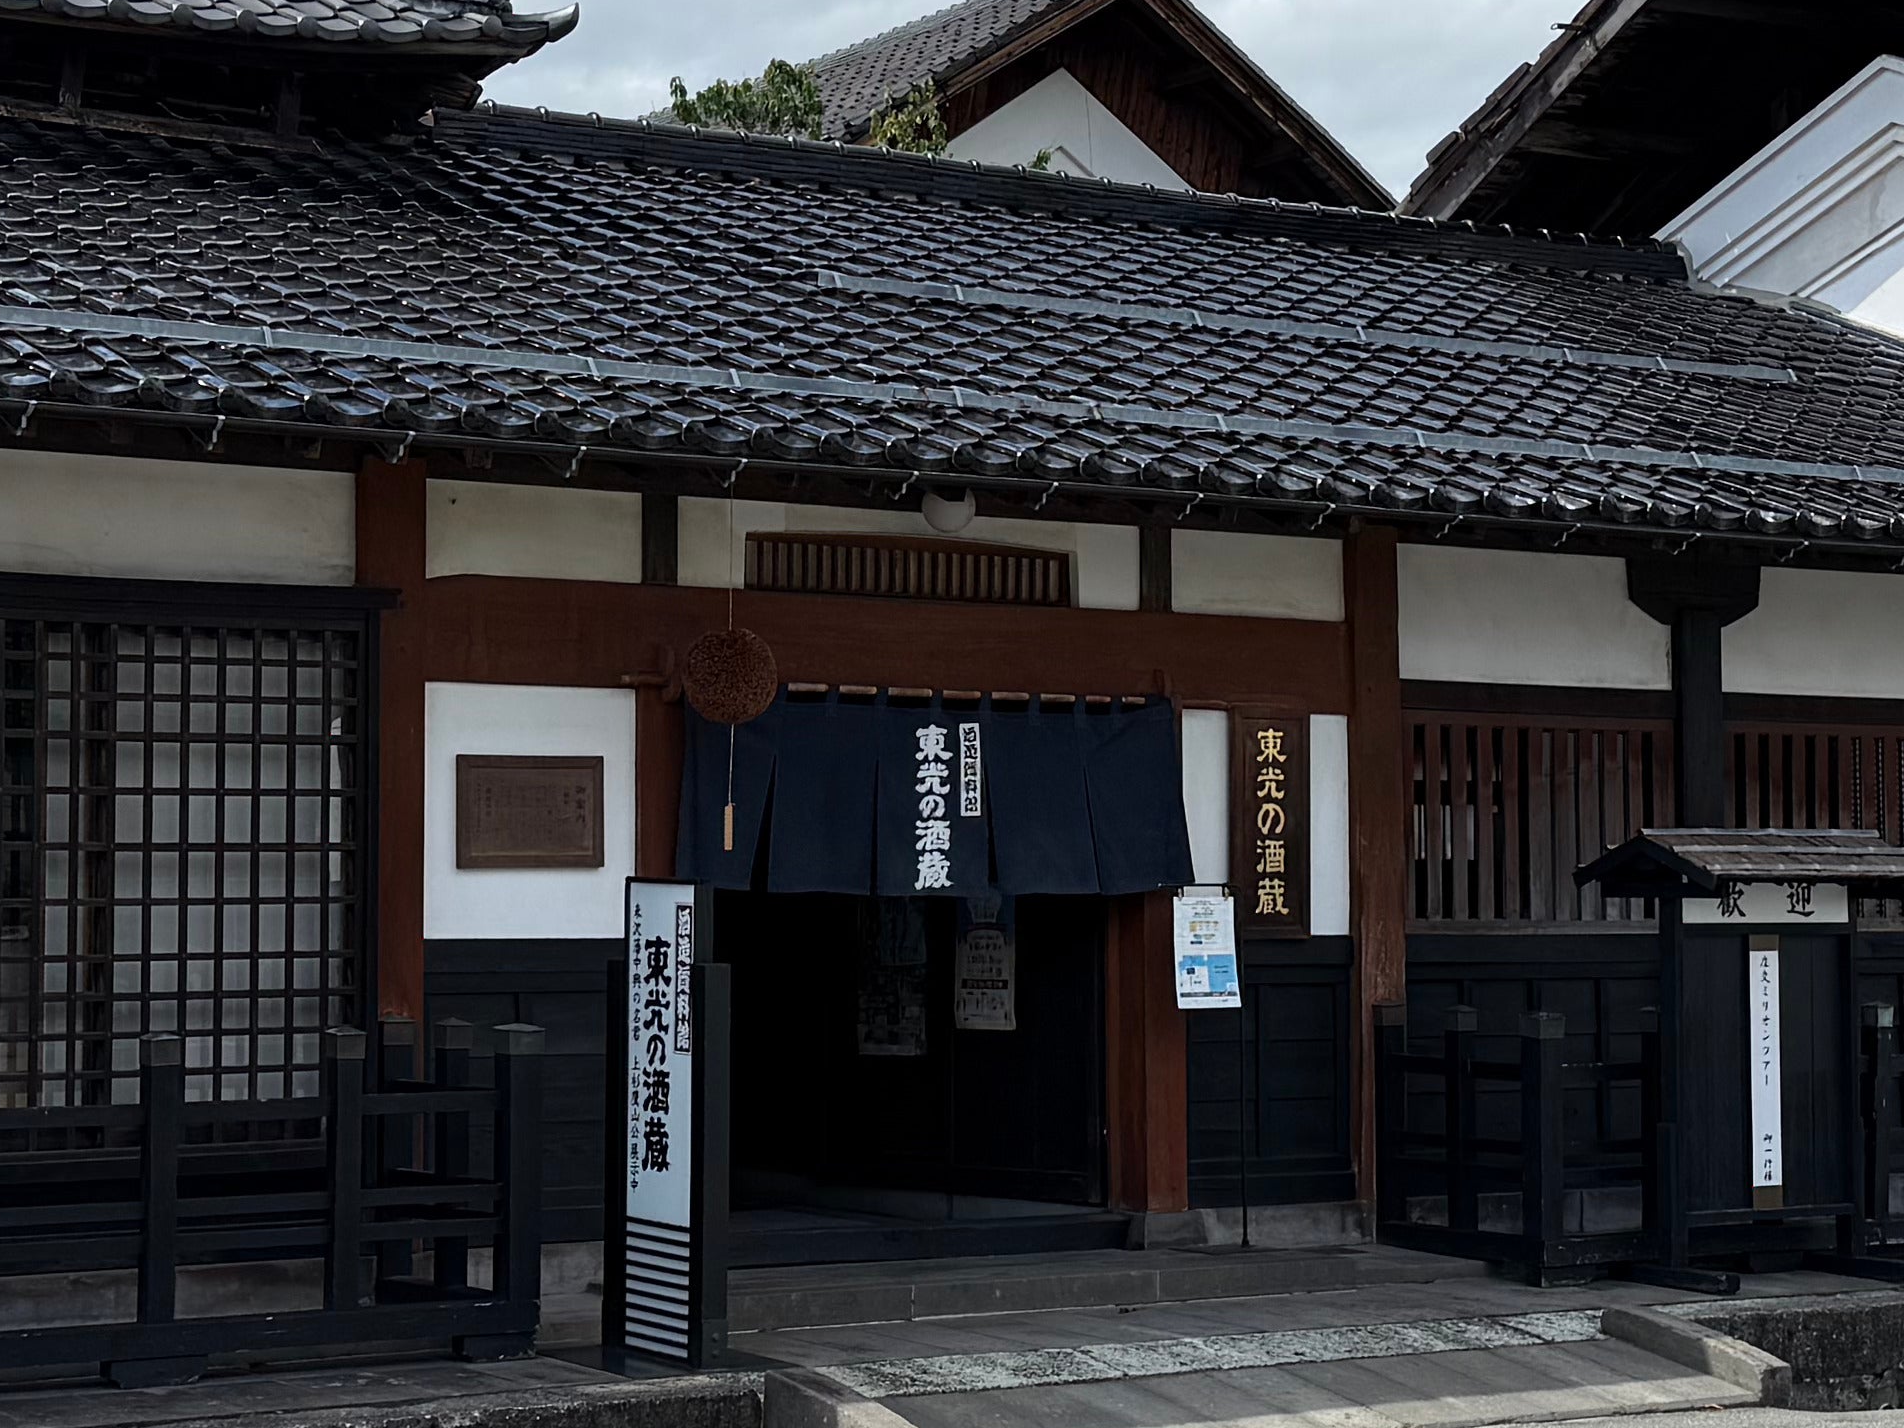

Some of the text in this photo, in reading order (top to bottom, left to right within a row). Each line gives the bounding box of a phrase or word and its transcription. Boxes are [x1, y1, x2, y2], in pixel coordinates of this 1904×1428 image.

[914, 724, 954, 891] 東光の酒蔵
[1255, 728, 1289, 915] 東光の酒蔵
[642, 935, 672, 1173] 東光の酒蔵
